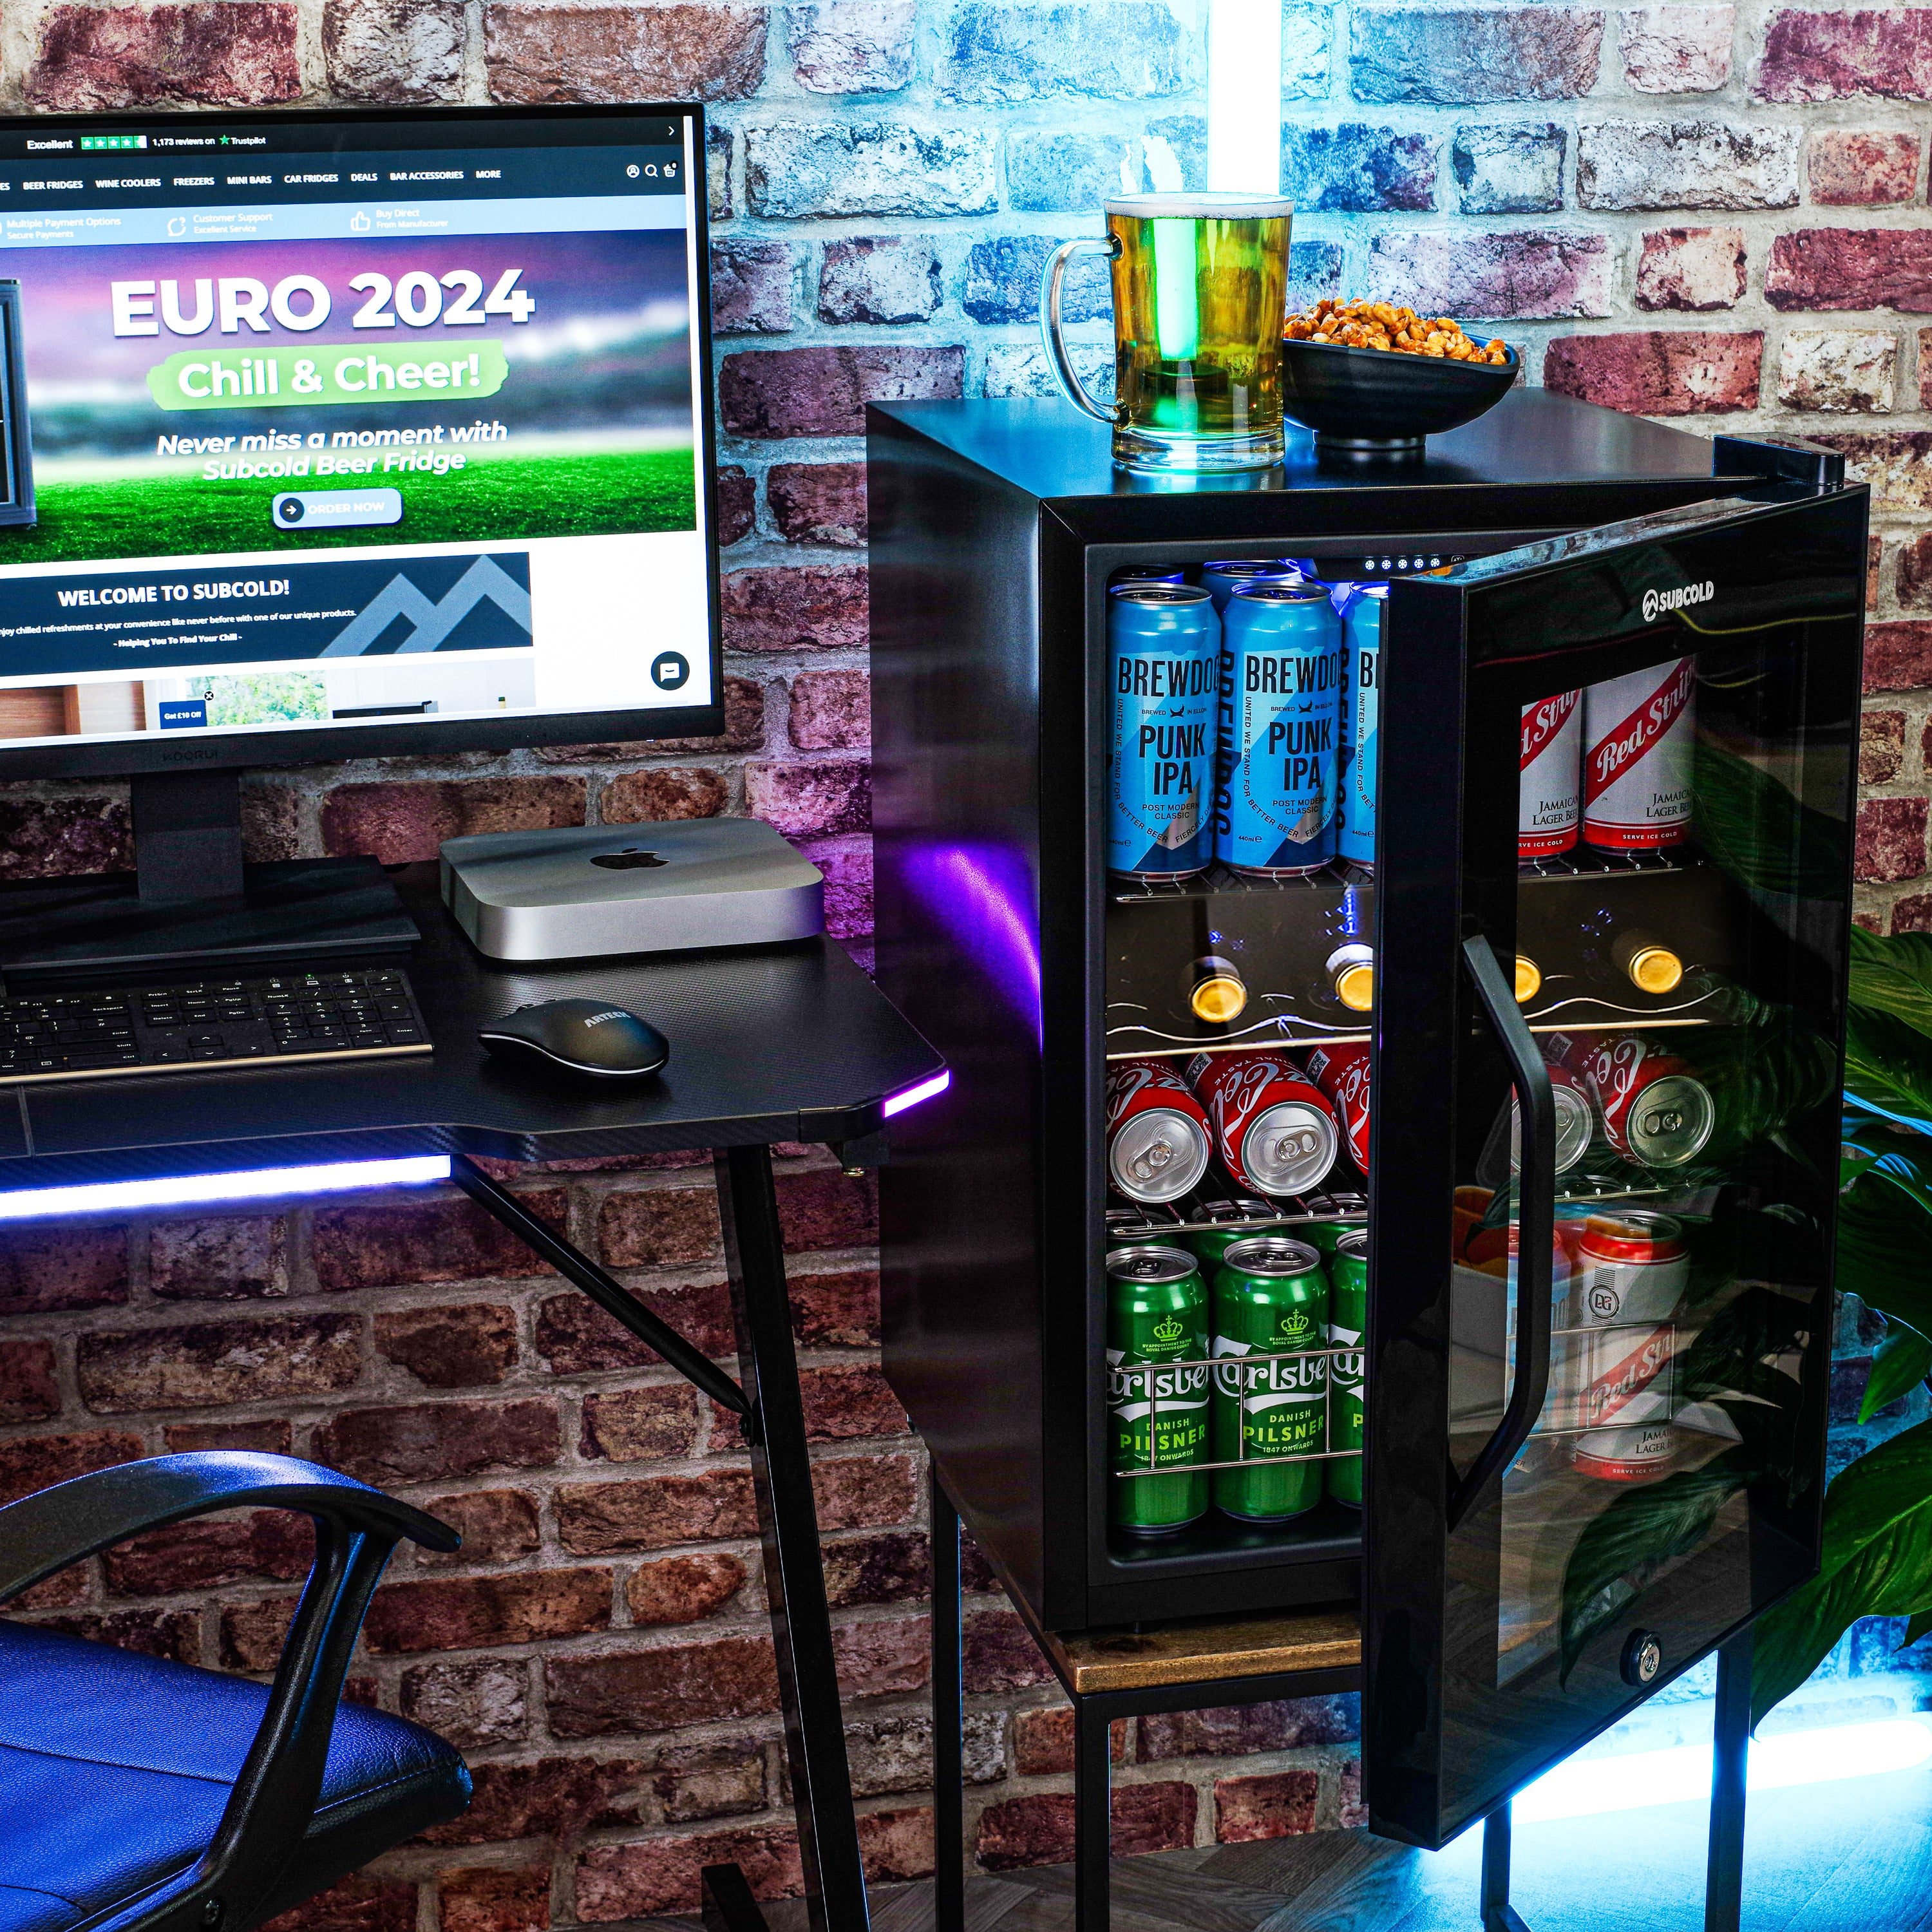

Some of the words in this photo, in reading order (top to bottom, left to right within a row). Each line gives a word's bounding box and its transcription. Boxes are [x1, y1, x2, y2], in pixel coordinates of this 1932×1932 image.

[27, 139, 73, 150] Excellent
[153, 138, 175, 147] 1,173
[175, 138, 204, 146] reviews
[231, 137, 266, 146] Trustpilot
[227, 176, 248, 185] MINI
[249, 175, 272, 184] BARS
[284, 175, 303, 184] CAR
[303, 174, 339, 183] FRIDGES
[350, 173, 377, 182] DEALS
[390, 171, 408, 181] BAR
[408, 171, 464, 180] ACCESSORIES
[475, 170, 502, 179] MORE
[23, 182, 46, 190] BEER
[46, 180, 84, 189] FRIDGES
[95, 180, 120, 188] WINE
[120, 178, 162, 187] COOLERS
[173, 177, 215, 186] FREEZERS
[193, 214, 236, 223] Customer
[238, 213, 273, 223] Support
[376, 209, 392, 219] Buy
[394, 209, 420, 218] Direct
[6, 220, 43, 230] Multiple
[44, 218, 84, 229] Payment
[86, 217, 121, 227] Options
[397, 219, 449, 228] Manufacturer
[7, 231, 35, 240] Secure
[36, 231, 74, 240] Payments
[111, 274, 332, 337] EURO
[348, 269, 536, 328] 2024
[178, 359, 278, 398] Chill
[291, 359, 323, 394] &
[334, 353, 480, 390] Cheer!
[157, 435, 236, 456] Never
[241, 428, 302, 451] miss
[307, 433, 325, 449] a
[331, 424, 444, 448] moment
[450, 420, 509, 443] with
[203, 455, 311, 480] Subcold
[316, 455, 378, 476] Beer
[383, 450, 467, 475] Fridge
[308, 504, 351, 515] ORDER
[354, 502, 385, 513] NOW
[57, 586, 158, 607] WELCOME
[161, 584, 189, 601] TO
[193, 580, 290, 600] SUBCOLD!
[1659, 580, 1714, 612] SUBCOLD
[15, 625, 41, 635] chilled
[42, 623, 94, 634] refreshments
[104, 623, 122, 632] your
[124, 620, 171, 629] convenience
[171, 618, 185, 626] like
[186, 617, 209, 625] never
[209, 615, 235, 625] before
[236, 614, 253, 623] with
[253, 614, 269, 622] one
[270, 612, 278, 620] of
[293, 611, 321, 621] unique
[321, 609, 357, 620] products.
[118, 639, 150, 649] Helping
[179, 635, 198, 644] Find
[198, 634, 218, 643] Your
[219, 633, 238, 641] Chill
[1115, 698, 1124, 730] UNITED
[1596, 719, 1646, 782] Red
[1646, 663, 1694, 735] Strip
[1244, 731, 1251, 744] WE
[1269, 717, 1332, 755] PUNK
[1358, 727, 1364, 739] WE
[1115, 734, 1122, 747] WE
[1139, 722, 1206, 759] PUNK
[1242, 748, 1251, 776] STAND
[1153, 761, 1193, 795] IPA
[1283, 755, 1321, 791] IPA
[1168, 802, 1199, 811] MODERN
[1298, 796, 1327, 806] MODERN
[1118, 802, 1145, 830] BETTER
[1248, 799, 1276, 826] BETTER
[1285, 806, 1319, 815] CLASSIC
[1646, 806, 1678, 818] LAGER
[1305, 810, 1332, 837] FIERCELY
[1533, 813, 1564, 825] LAGER
[1146, 827, 1168, 843] BEER
[1175, 817, 1205, 843] FIERCELY
[1277, 823, 1299, 838] BEER
[1214, 1059, 1252, 1086] TASTE
[1591, 1363, 1638, 1419] Red
[1269, 1409, 1311, 1423] DANISH
[1243, 1414, 1323, 1443] PILSNER
[1282, 1439, 1314, 1452] ONWARDS
[1636, 1442, 1665, 1454] LAGER
[1160, 1449, 1194, 1461] ONWARDS
